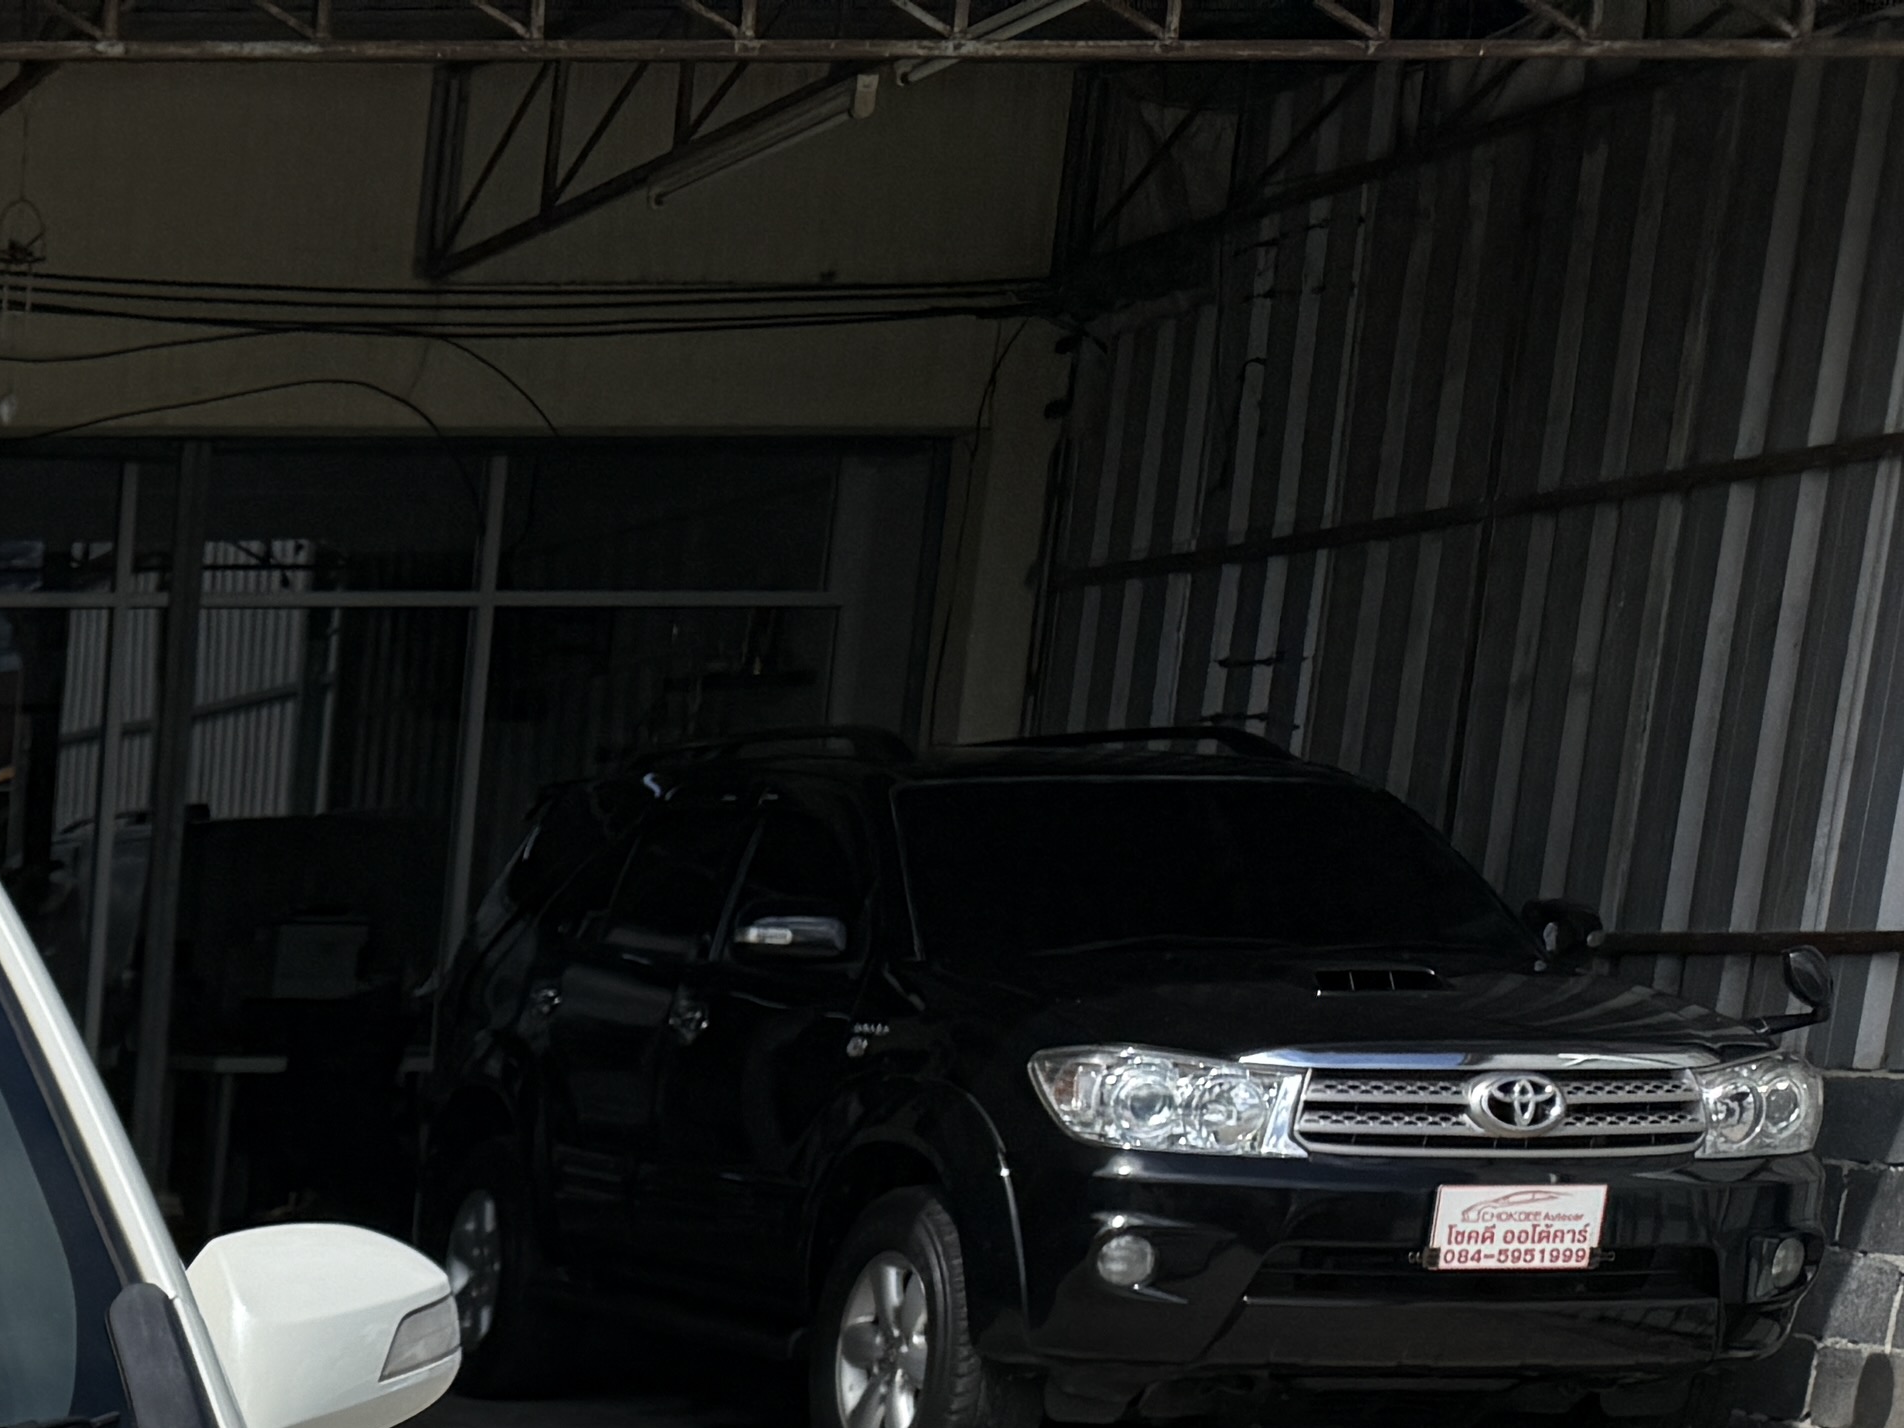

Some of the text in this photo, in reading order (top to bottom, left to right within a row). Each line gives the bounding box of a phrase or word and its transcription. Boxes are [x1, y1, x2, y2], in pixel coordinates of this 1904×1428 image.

[1447, 1223, 1590, 1246] โชคดี ออโต้คาร์
[1443, 1247, 1587, 1265] 084-5951999
